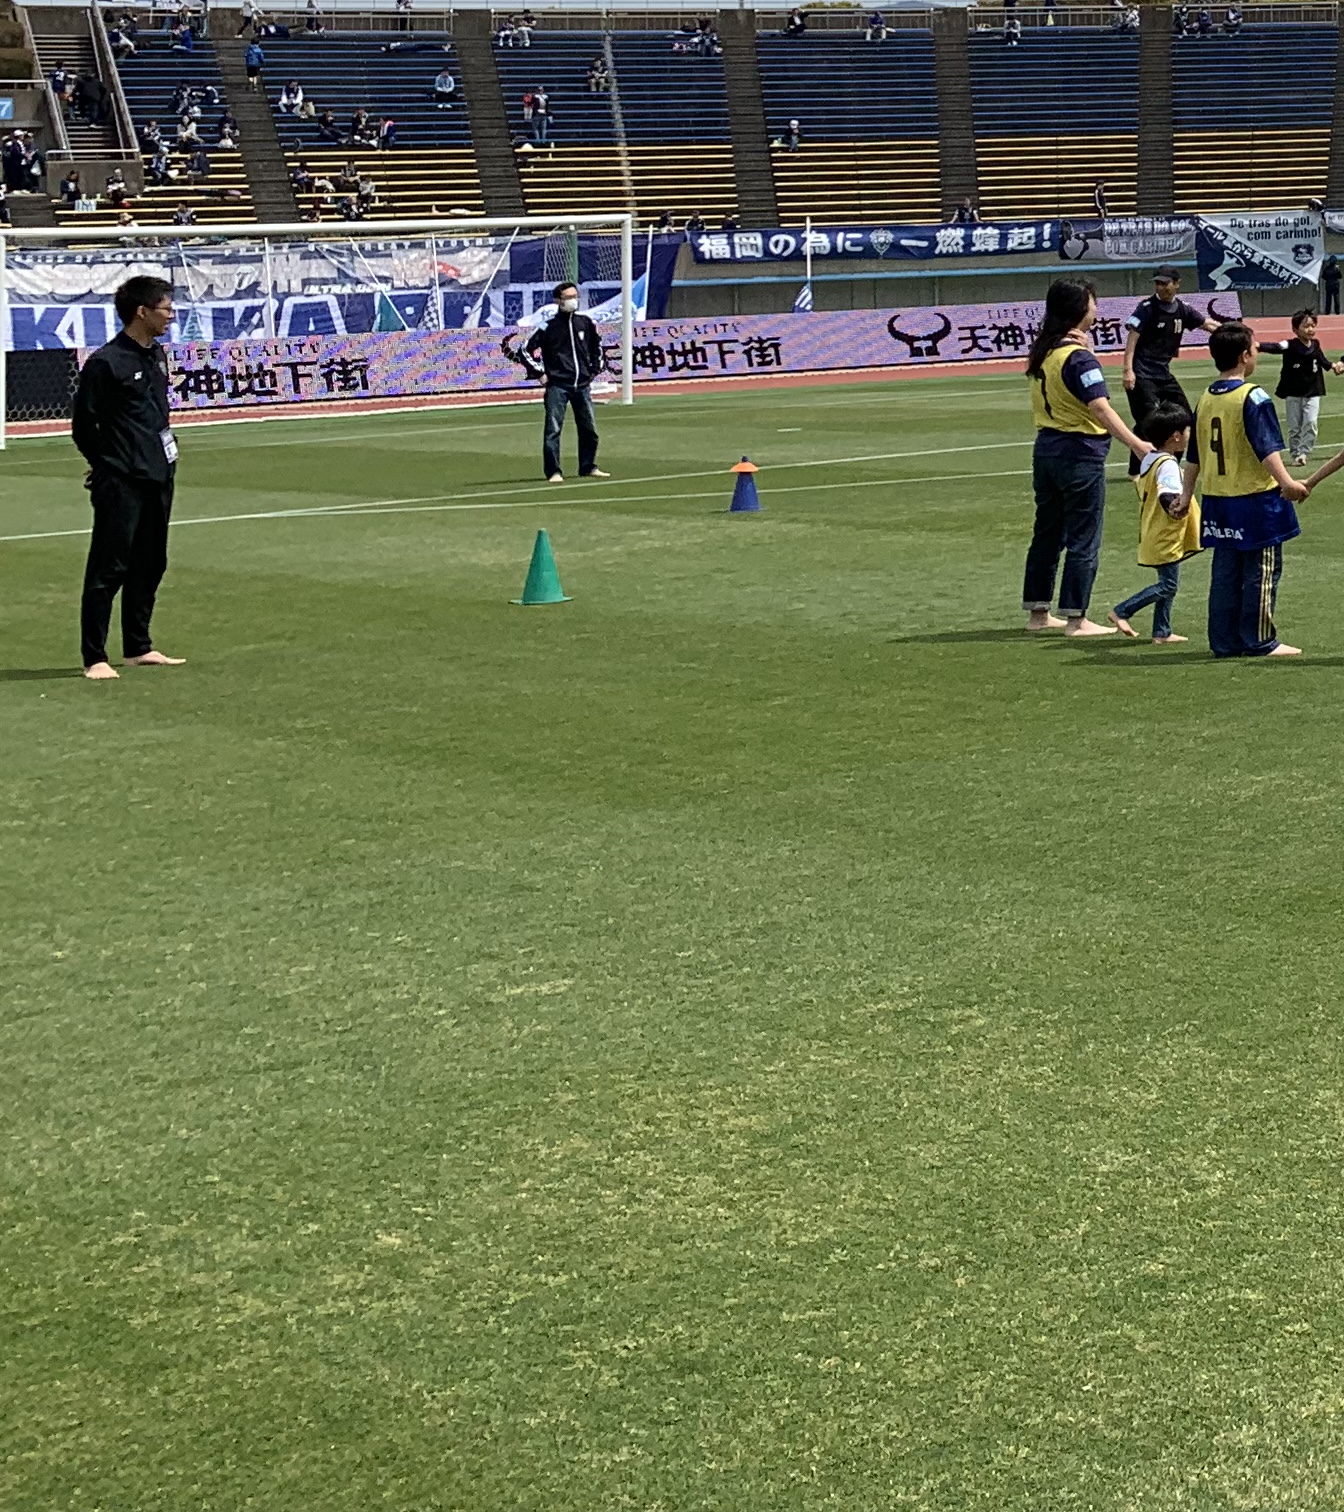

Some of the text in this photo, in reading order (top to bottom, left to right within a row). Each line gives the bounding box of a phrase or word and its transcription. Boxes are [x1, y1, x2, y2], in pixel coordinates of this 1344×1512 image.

[1248, 218, 1271, 228] tras
[1275, 217, 1289, 227] do
[1247, 227, 1322, 241] com carinho!
[698, 231, 863, 260] 福岡の為に
[1210, 416, 1226, 476] 9
